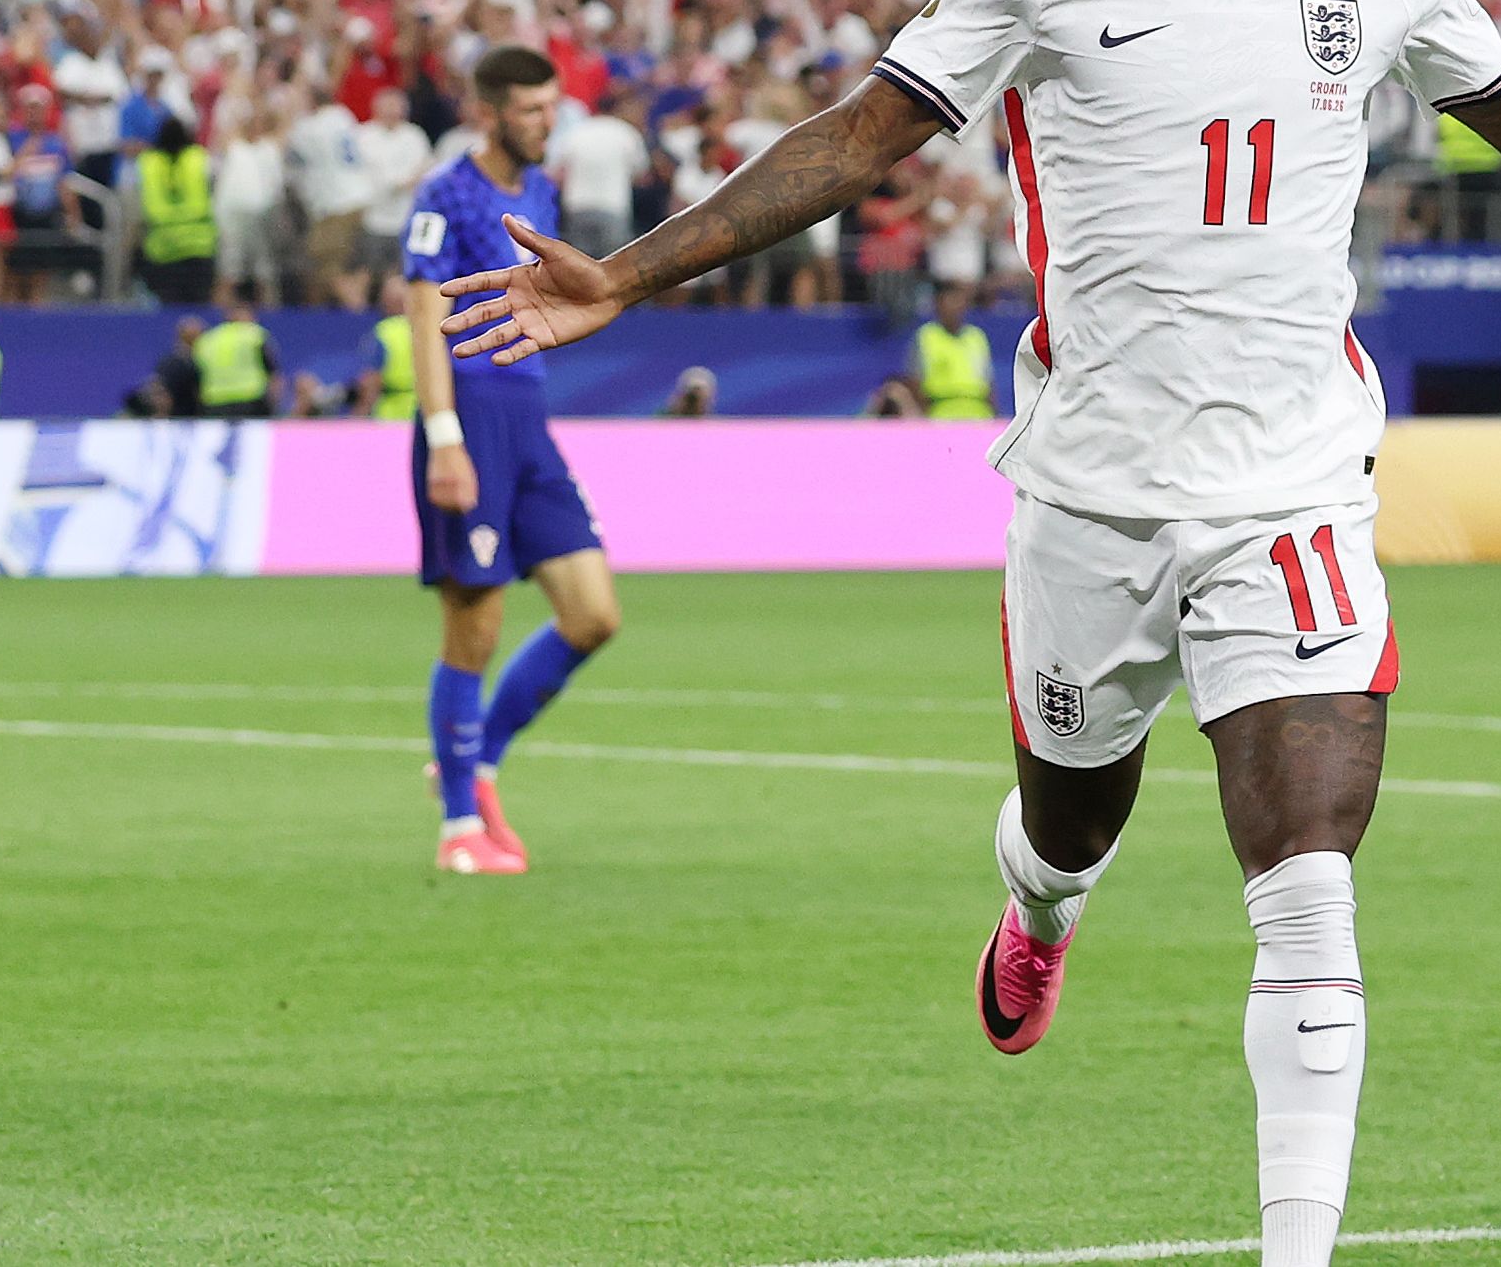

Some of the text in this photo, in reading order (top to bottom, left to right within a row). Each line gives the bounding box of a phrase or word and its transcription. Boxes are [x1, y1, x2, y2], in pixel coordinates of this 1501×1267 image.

[1310, 81, 1348, 95] CROATIA
[1311, 98, 1344, 112] 17.06.26
[1200, 118, 1275, 226] 11
[1269, 524, 1357, 632] 11
